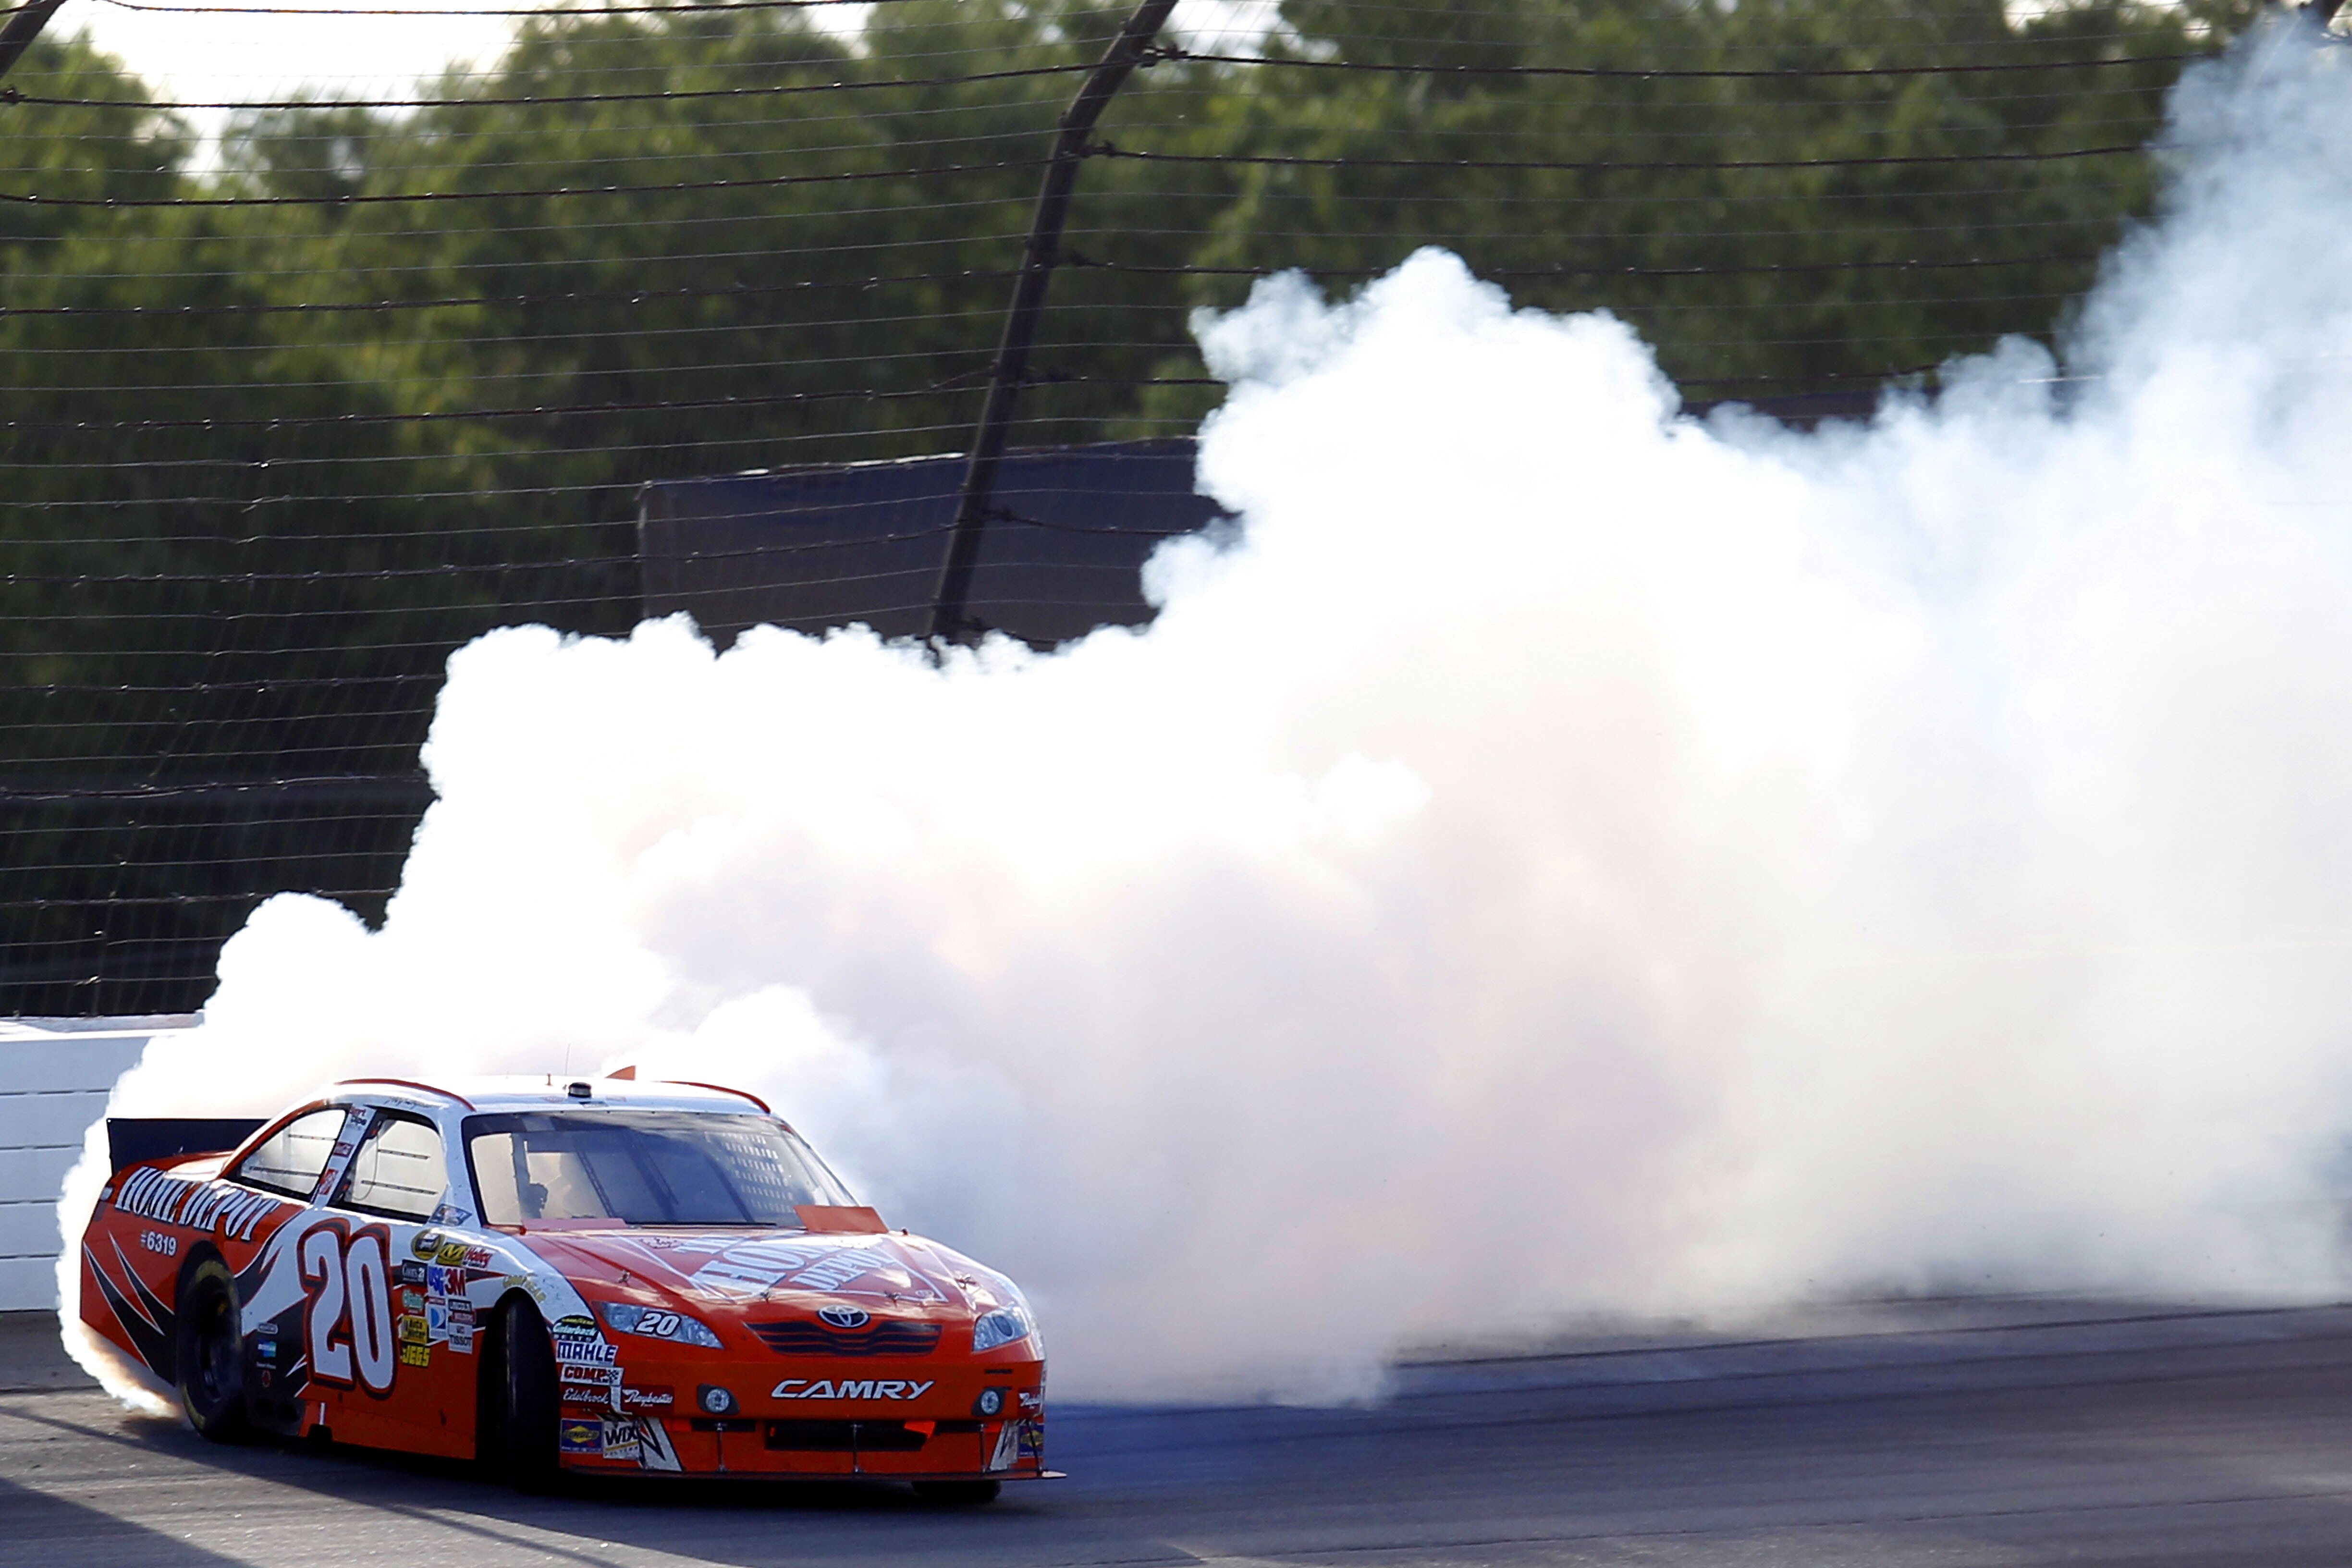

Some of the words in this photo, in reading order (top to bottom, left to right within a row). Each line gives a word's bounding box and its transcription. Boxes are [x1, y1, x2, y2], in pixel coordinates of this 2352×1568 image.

[444, 1268, 466, 1296] 3M
[302, 1225, 397, 1393] 20
[635, 1312, 680, 1336] 20
[402, 1344, 430, 1367] JEGS
[558, 1342, 617, 1362] MAHLE
[564, 1366, 607, 1380] COMP
[563, 1387, 609, 1404] Edelbrock
[772, 1379, 935, 1399] CAMRY
